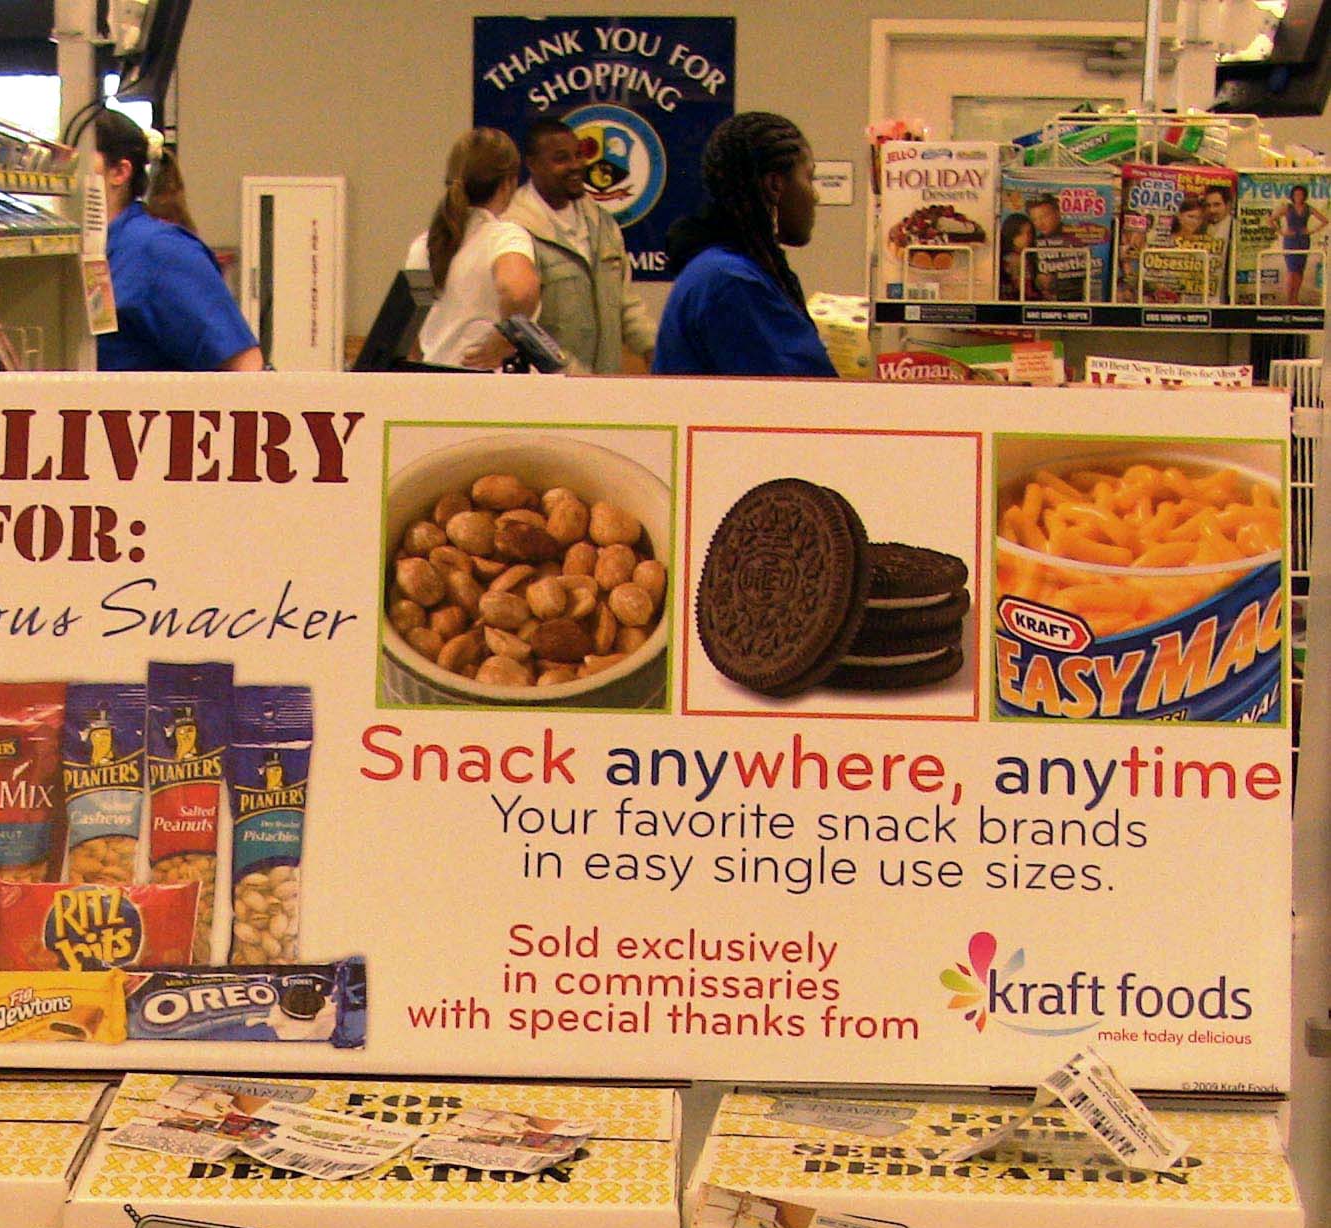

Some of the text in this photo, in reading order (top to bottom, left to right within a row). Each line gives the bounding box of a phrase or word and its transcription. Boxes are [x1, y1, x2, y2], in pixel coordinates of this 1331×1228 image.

[483, 27, 727, 95] THANK YOU FOR
[529, 63, 683, 113] SHOPPING
[886, 169, 985, 189] HOLIDAY
[1060, 198, 1106, 217] OAPS
[1130, 188, 1184, 211] SOAPS
[100, 579, 357, 640] Snacker
[1015, 613, 1070, 641] KRAFT
[996, 587, 1281, 718] EASY MAC
[64, 761, 140, 792] PLANTERS
[151, 757, 221, 785] PLANTERS
[359, 725, 1283, 809] Snack anywhere, anytime
[0, 781, 55, 809] MIX
[180, 806, 215, 817] Salted
[240, 789, 305, 812] PLANTERS
[72, 811, 132, 825] Cashews
[155, 817, 214, 832] Peanuts
[491, 795, 1148, 849] Your favorite snack brands
[523, 847, 1115, 895] in easy single use sizes.
[53, 889, 124, 937] RITZ
[508, 924, 839, 968] Sold exclusively
[503, 964, 840, 1000] in commissaries
[989, 969, 1253, 1020] kraft foods
[143, 981, 278, 1023] OREO
[408, 999, 920, 1043] with special thanks from
[1099, 1029, 1252, 1046] make today delicious
[1193, 1082, 1219, 1092] 2009
[1221, 1083, 1245, 1092] Kraft
[1248, 1084, 1279, 1093] Foods
